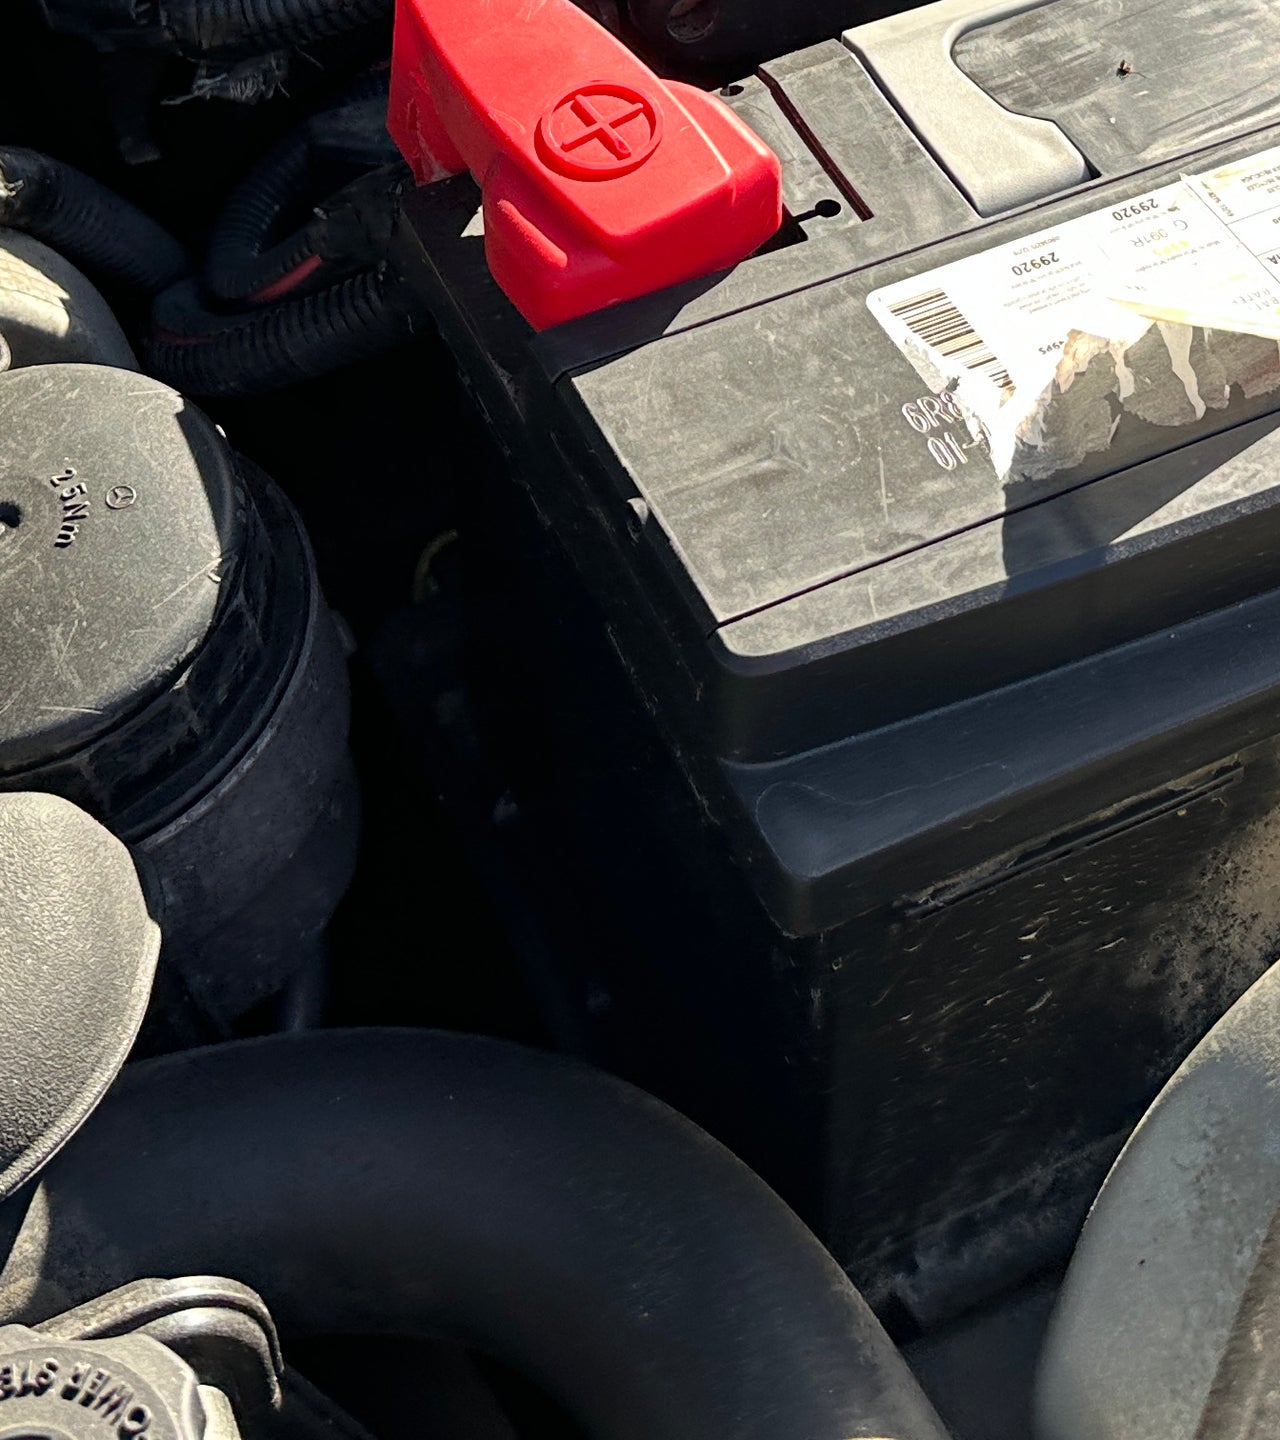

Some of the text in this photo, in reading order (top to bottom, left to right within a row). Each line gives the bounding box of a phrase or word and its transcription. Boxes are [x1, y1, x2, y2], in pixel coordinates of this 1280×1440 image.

[1109, 198, 1160, 221] 29920
[1008, 251, 1061, 276] 29920
[50, 467, 92, 548] 25Nm
[59, 1361, 152, 1440] OWER
